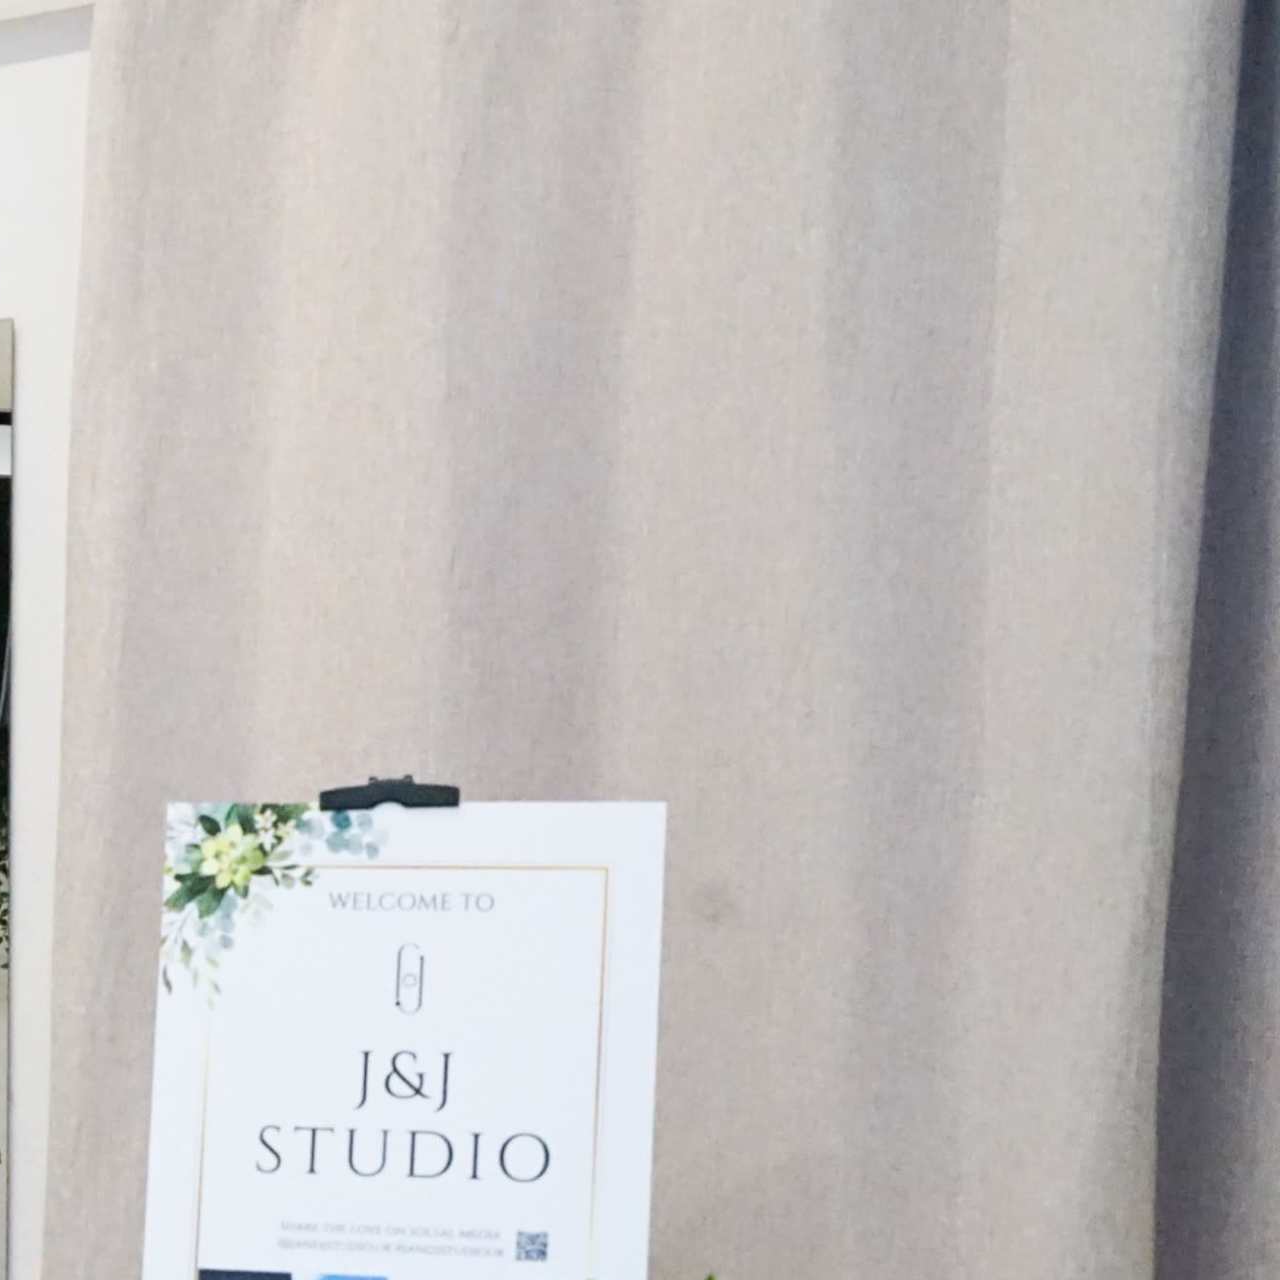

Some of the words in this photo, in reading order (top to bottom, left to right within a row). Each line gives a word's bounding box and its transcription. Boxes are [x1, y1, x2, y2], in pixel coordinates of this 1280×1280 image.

[329, 891, 452, 912] WELCOME
[462, 893, 495, 912] TO
[353, 1050, 454, 1112] J&J
[255, 1124, 553, 1183] STUDIO
